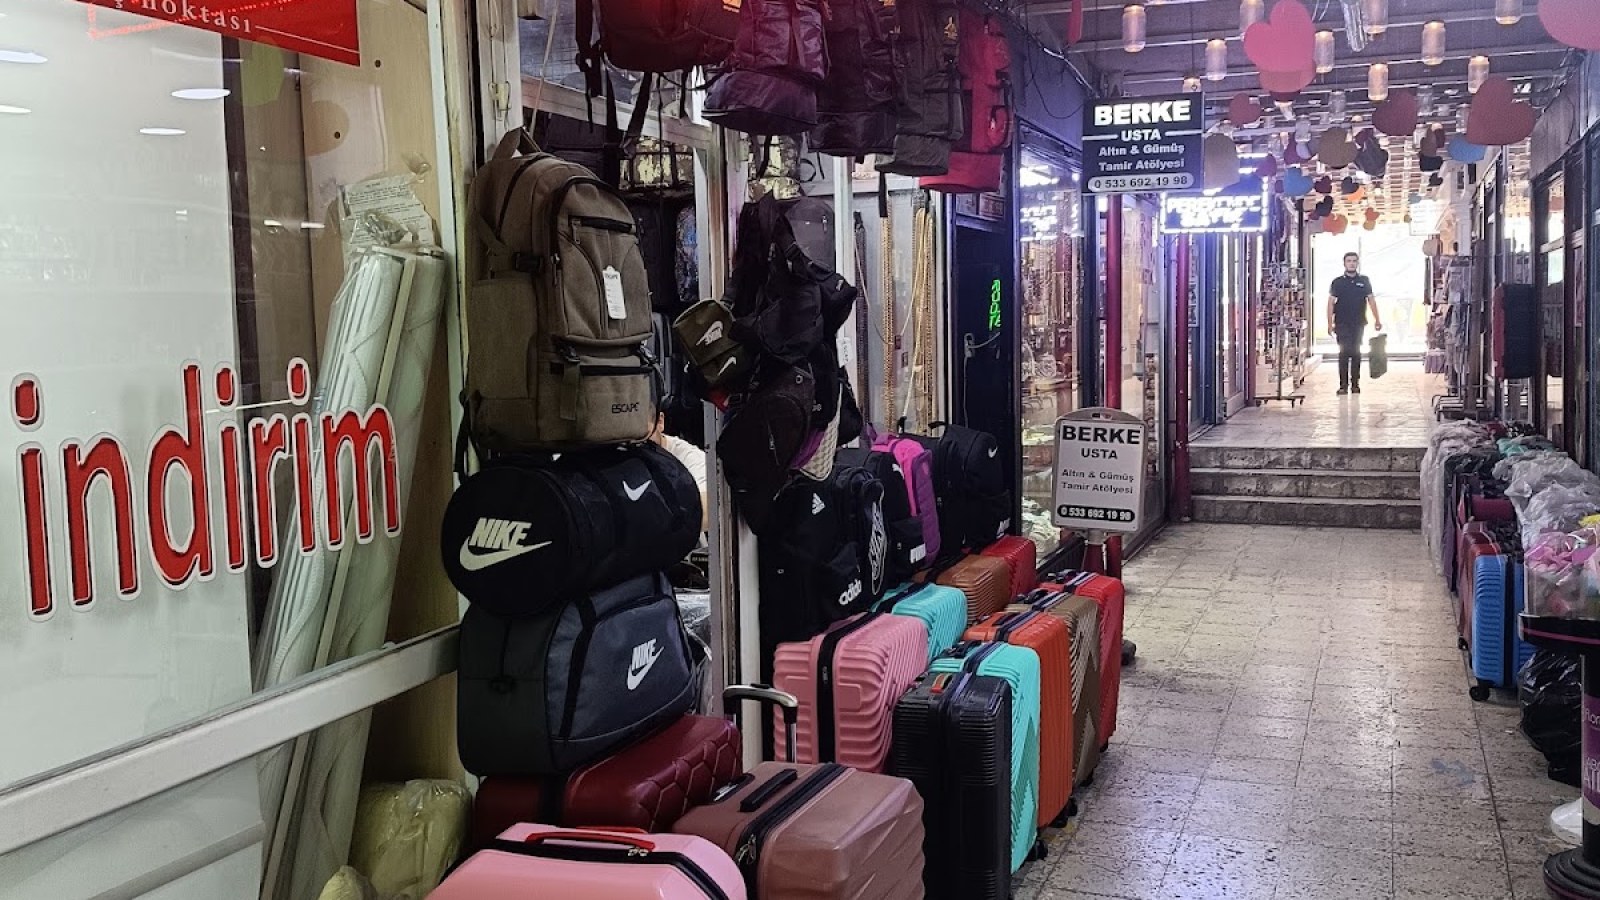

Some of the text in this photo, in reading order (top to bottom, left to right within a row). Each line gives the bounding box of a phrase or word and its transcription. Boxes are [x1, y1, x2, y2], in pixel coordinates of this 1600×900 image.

[1094, 100, 1191, 126] BERKE
[1121, 129, 1161, 141] USTA
[1098, 143, 1185, 157] Altın & Gümüş
[1098, 159, 1184, 171] Tamir Atölyesi
[1105, 179, 1126, 188] 533
[1062, 425, 1141, 445] BERKE
[1081, 447, 1118, 459] USTA
[1062, 469, 1085, 478] Altın
[1099, 471, 1134, 482] Gümüş
[11, 358, 401, 621] indirim
[1062, 482, 1133, 494] Tamir Atölyesi
[1069, 507, 1086, 517] 533
[1106, 510, 1118, 519] 19
[469, 517, 532, 549] NIKE
[632, 638, 657, 670] NIKE
